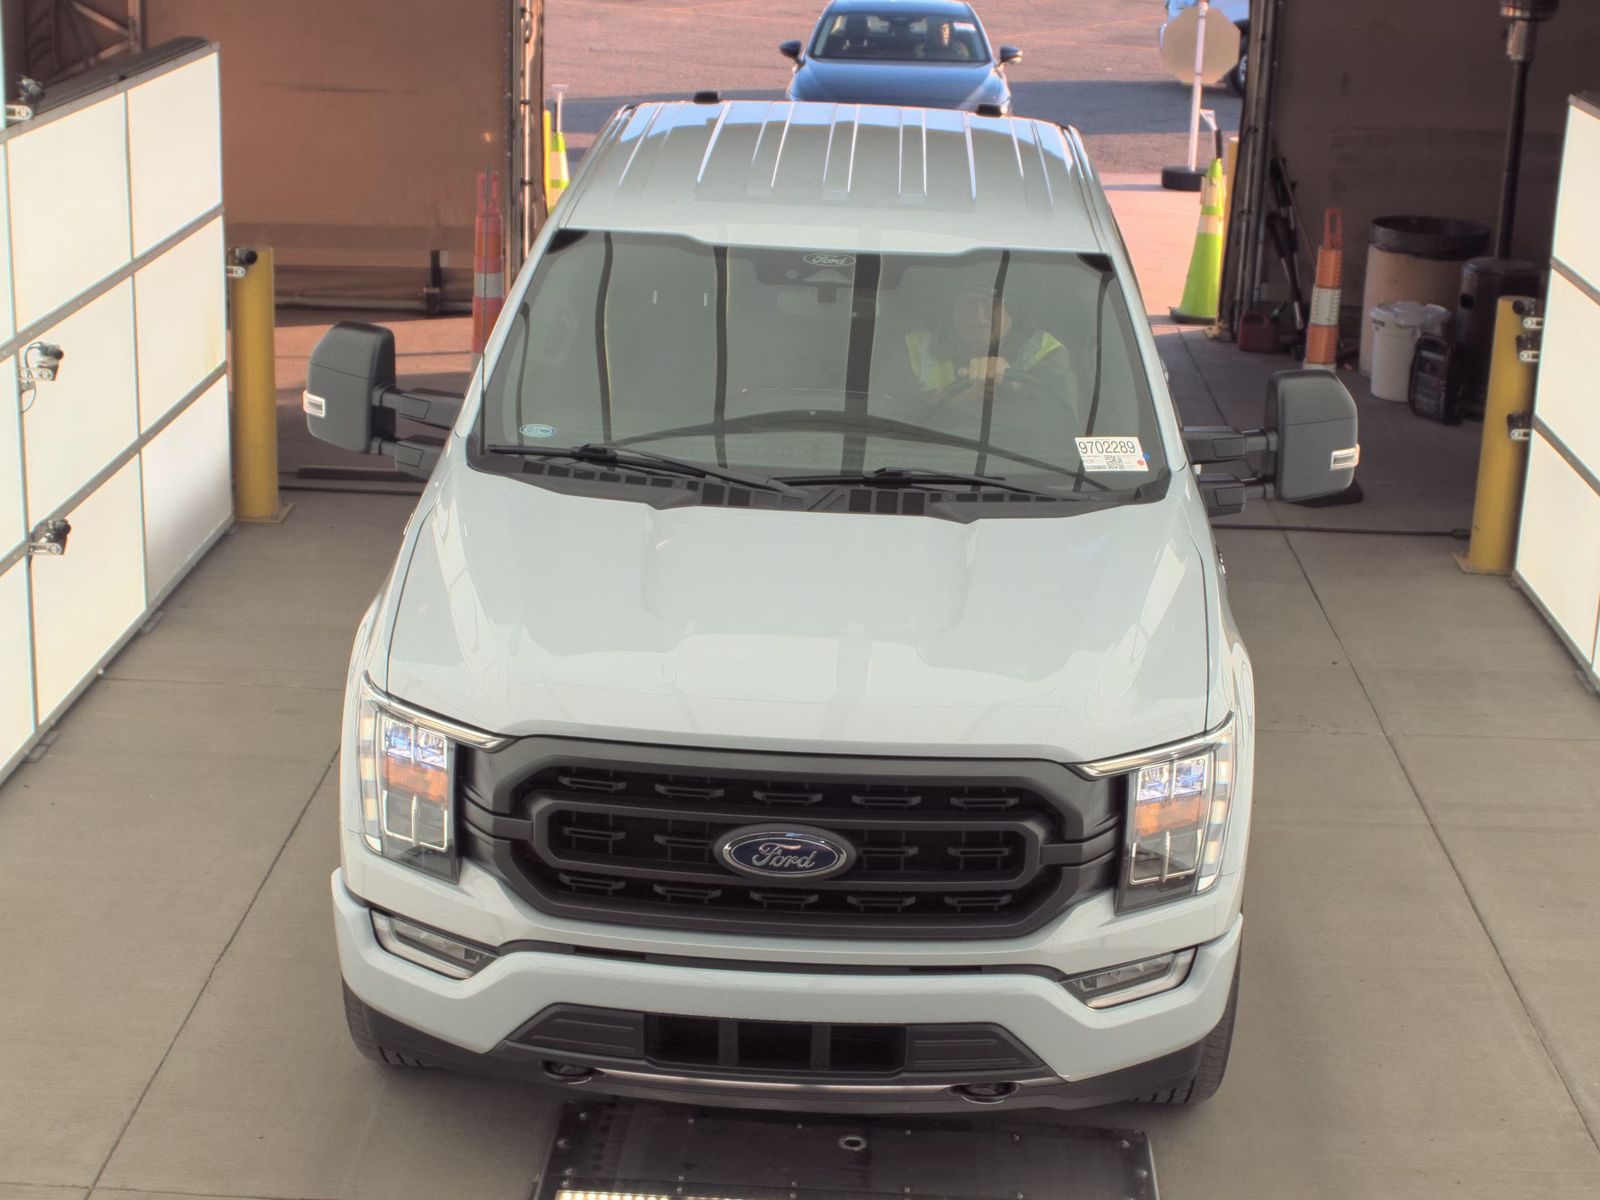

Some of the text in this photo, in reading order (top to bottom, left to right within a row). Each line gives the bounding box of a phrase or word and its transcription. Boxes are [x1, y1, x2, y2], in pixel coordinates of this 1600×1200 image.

[812, 253, 848, 264] Ford
[1078, 440, 1136, 454] 9702289
[752, 842, 817, 868] Ford
